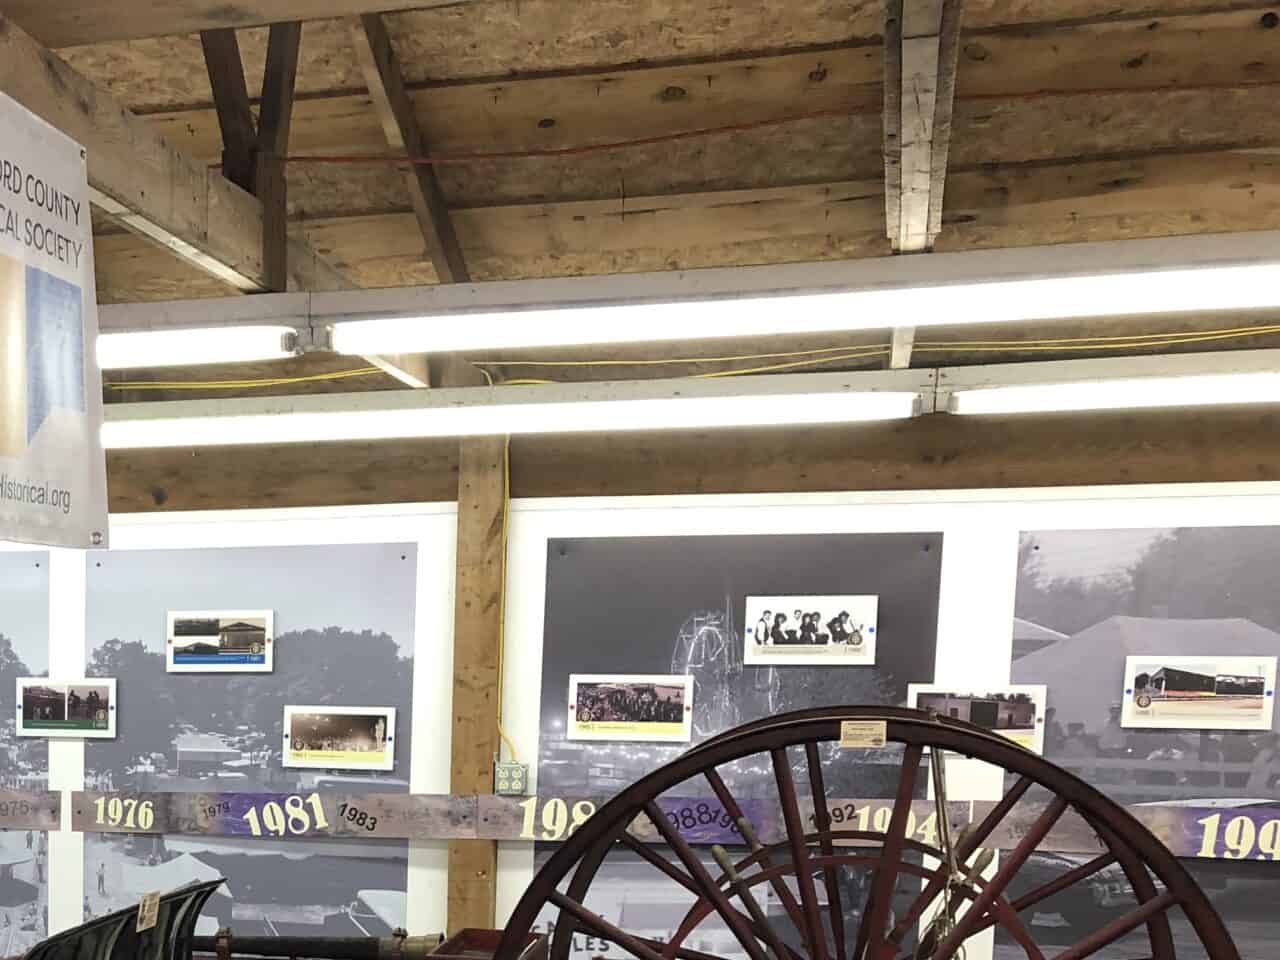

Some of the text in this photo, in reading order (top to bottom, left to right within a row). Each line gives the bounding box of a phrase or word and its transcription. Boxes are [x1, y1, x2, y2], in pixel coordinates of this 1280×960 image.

[25, 174, 81, 225] COUNTY
[24, 218, 83, 269] SOCIETY
[94, 795, 155, 831] 1976
[242, 792, 329, 837] 1981
[338, 802, 379, 832] 1983
[518, 796, 596, 842] 198
[666, 802, 712, 830] 988
[808, 803, 858, 826] 192
